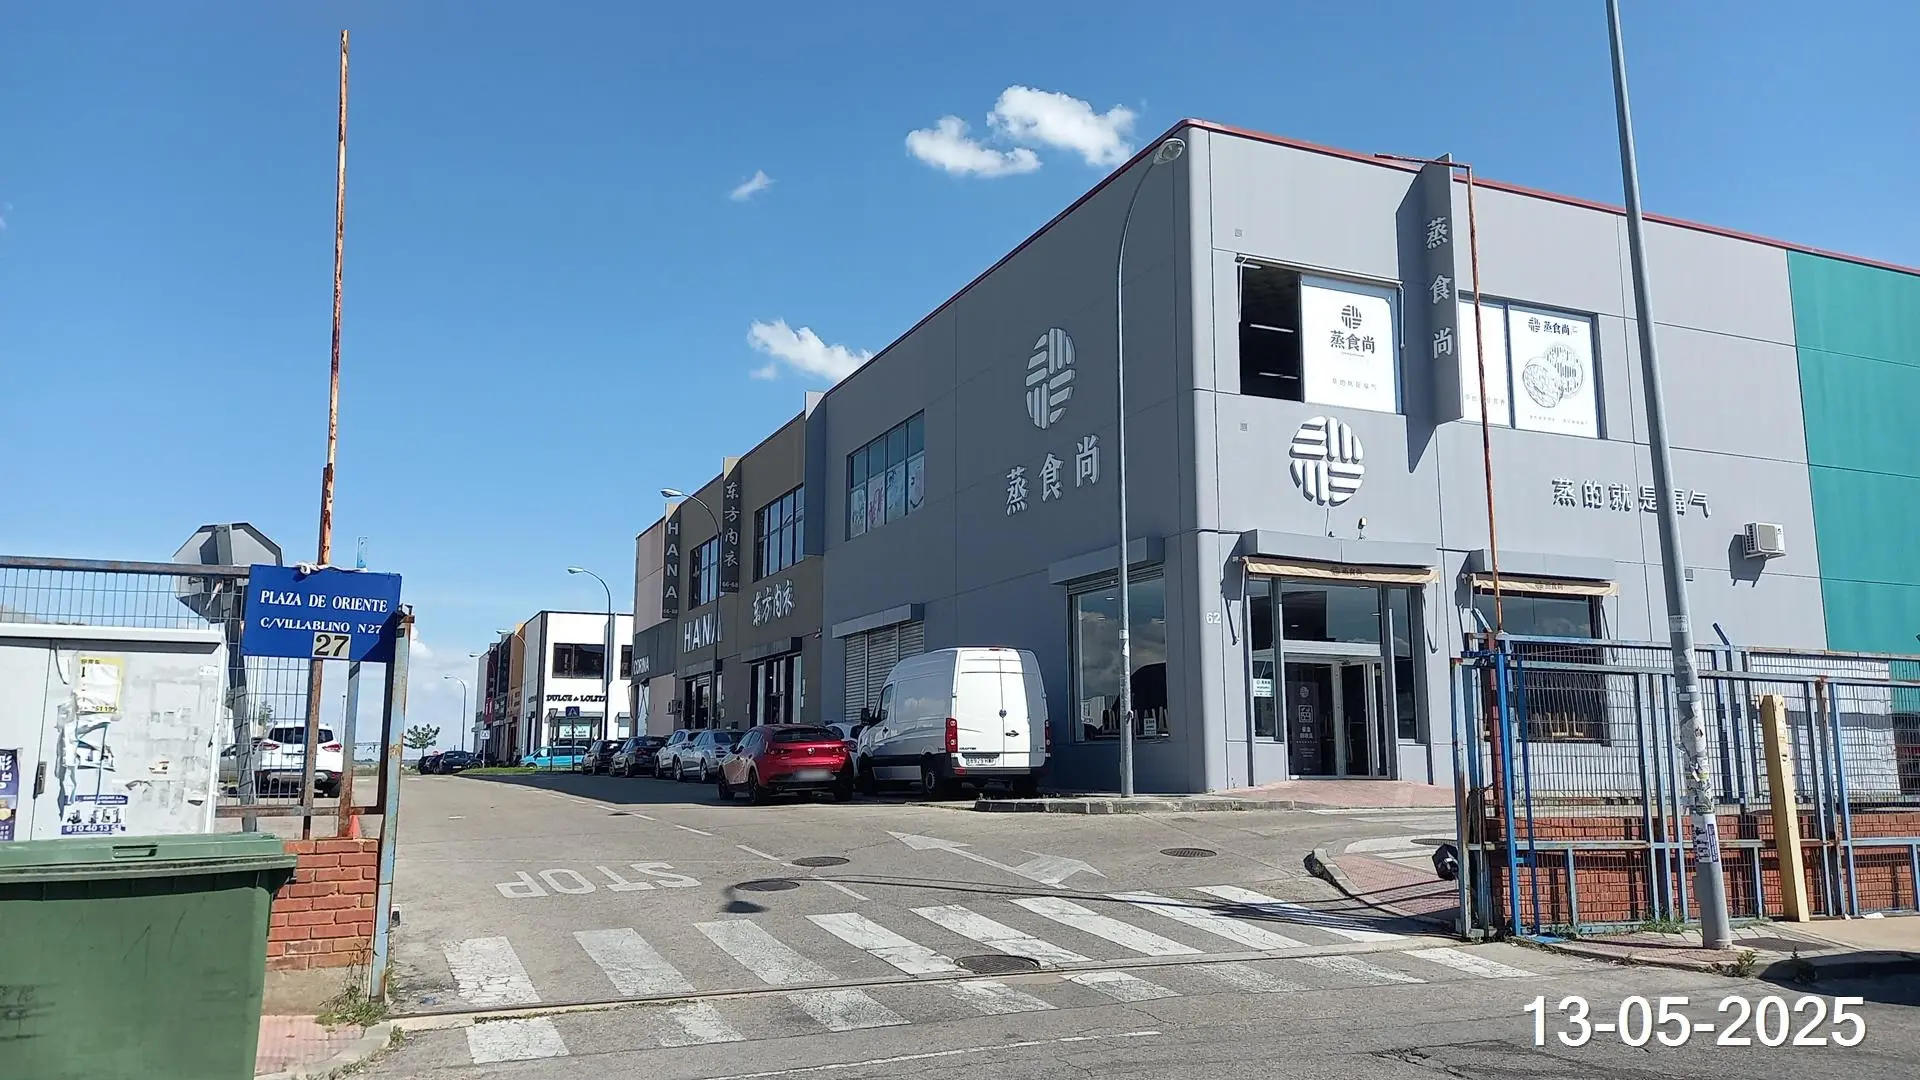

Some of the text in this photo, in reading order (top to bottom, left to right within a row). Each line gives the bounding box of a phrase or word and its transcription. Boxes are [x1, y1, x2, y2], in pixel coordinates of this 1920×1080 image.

[1426, 216, 1453, 359] 蒸食尚
[1543, 321, 1570, 336] 蒸食尚
[1330, 329, 1375, 355] 蒸食尚
[1006, 434, 1100, 516] 蒸食尚
[725, 482, 740, 566] 东方内衣
[666, 522, 679, 598] HANA
[260, 591, 388, 613] PLAZA DE ORIENTE
[260, 617, 350, 632] C/VILLABLINO
[1206, 612, 1220, 624] 62
[314, 634, 349, 657] 27
[546, 694, 573, 702] DULCE
[495, 862, 701, 898] STOP
